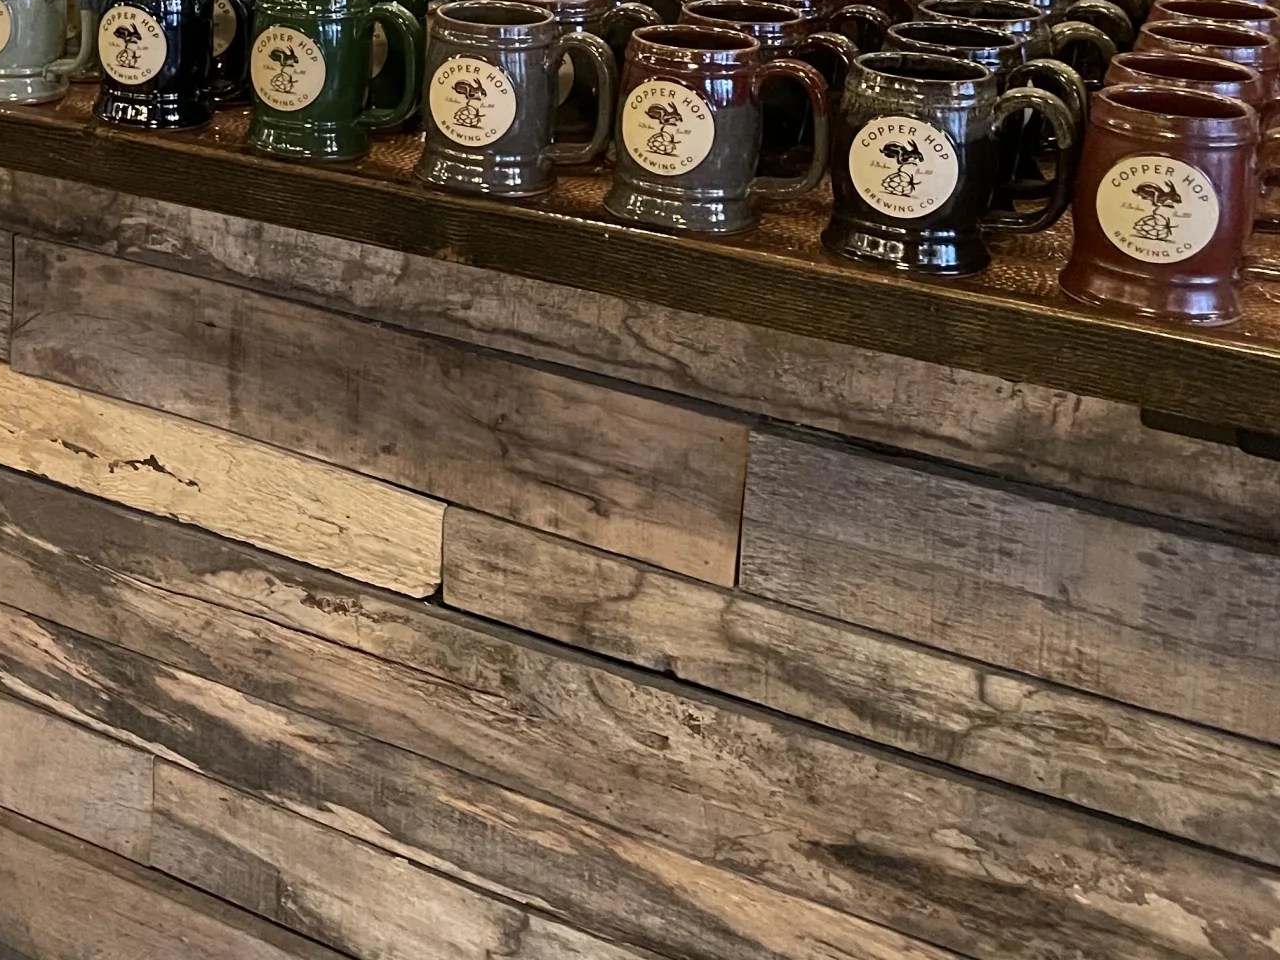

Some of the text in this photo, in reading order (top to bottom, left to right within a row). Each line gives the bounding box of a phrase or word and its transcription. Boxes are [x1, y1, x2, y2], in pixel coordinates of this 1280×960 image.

[102, 11, 160, 39] COPPER HOP
[257, 33, 318, 62] COPPER HOP
[437, 64, 508, 95] COPPER HOP
[630, 88, 706, 121] COPPER HOP
[441, 120, 481, 142] BREWING
[861, 124, 950, 161] COPPER HOP
[1111, 164, 1210, 202] COPPER HOP
[864, 187, 914, 213] BREWING
[1114, 230, 1170, 257] BREWING
